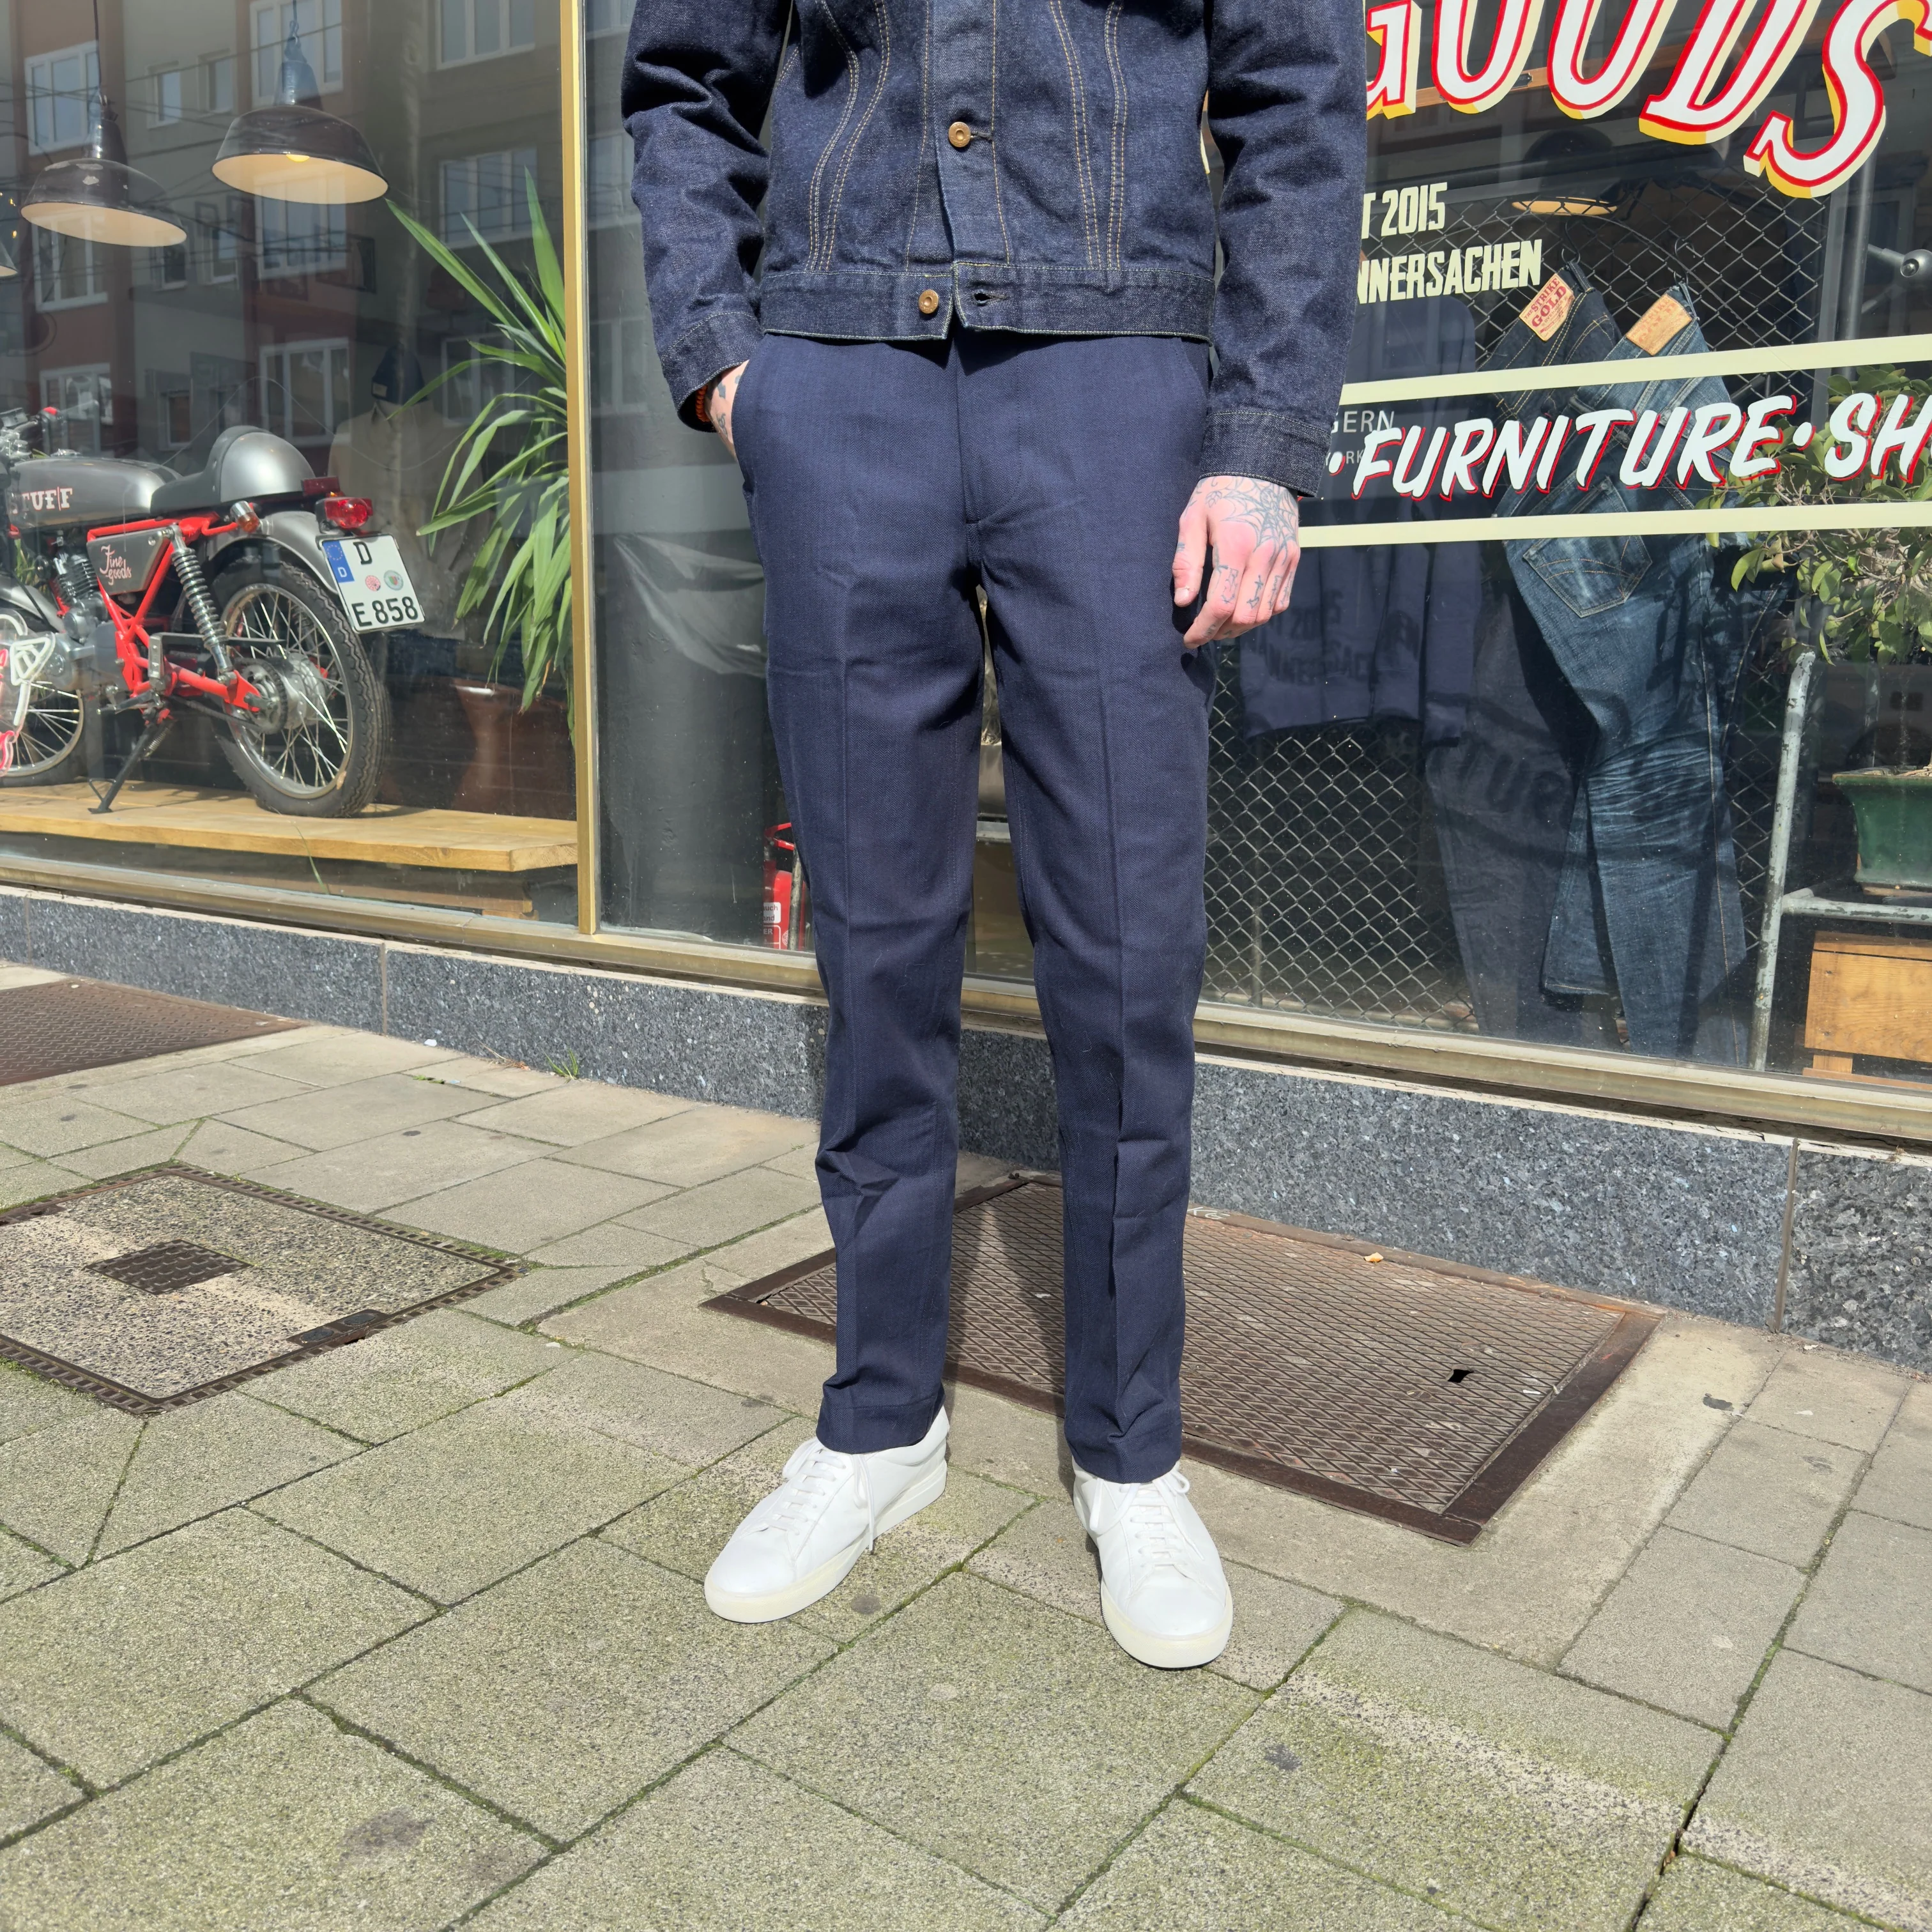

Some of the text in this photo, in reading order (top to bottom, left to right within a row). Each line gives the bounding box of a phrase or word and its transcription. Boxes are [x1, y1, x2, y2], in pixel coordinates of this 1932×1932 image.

[1366, 0, 1932, 199] OODS
[1381, 182, 1448, 236] 2015
[1531, 277, 1560, 312] STRIKE
[1531, 286, 1567, 327] GOLD
[1325, 449, 1364, 466] YRK
[1352, 392, 1932, 502] FURNITURE SH
[100, 544, 123, 574] Fine
[353, 542, 372, 565] D
[105, 559, 132, 586] goods
[337, 567, 348, 578] D
[351, 596, 418, 627] E 858
